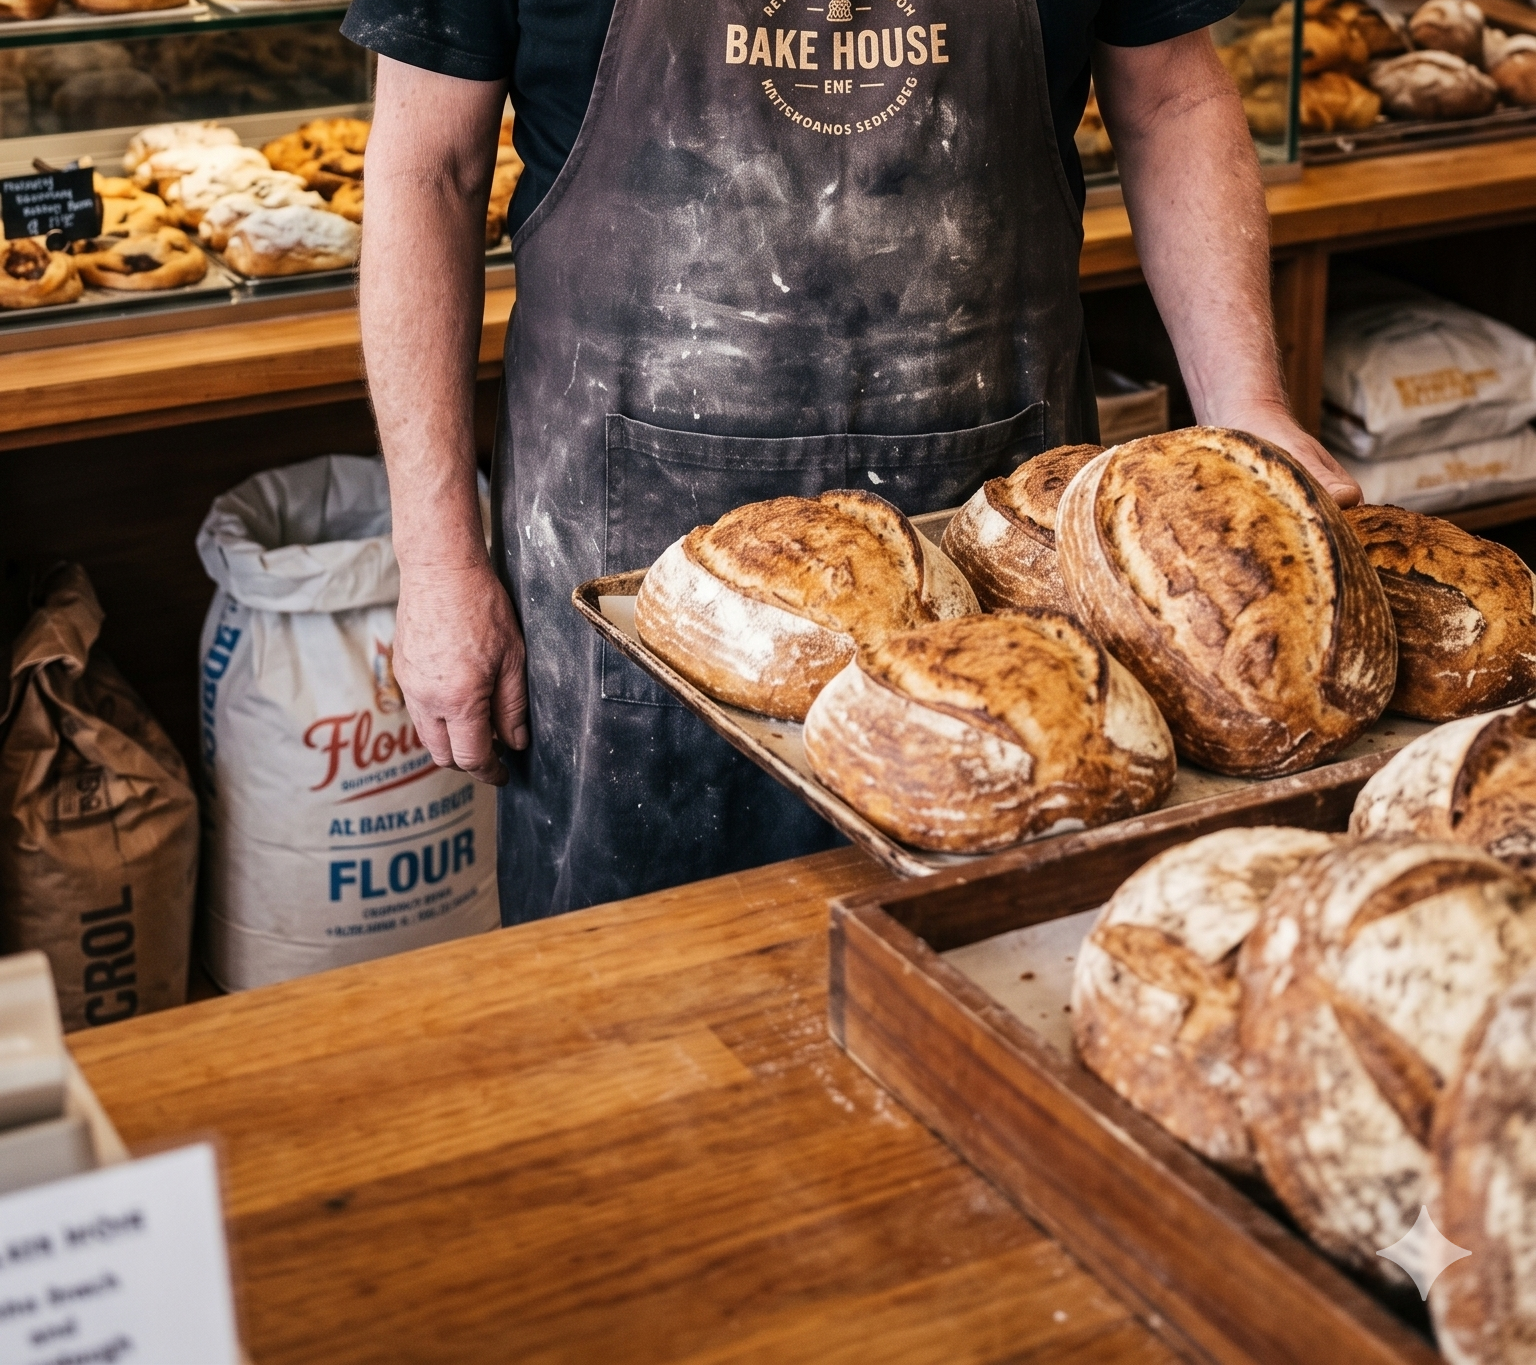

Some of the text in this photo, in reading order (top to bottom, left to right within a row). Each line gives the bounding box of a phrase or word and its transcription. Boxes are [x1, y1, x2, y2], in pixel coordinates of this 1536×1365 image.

[725, 23, 949, 70] BAKE HOUSE
[824, 79, 853, 94] ENE
[329, 828, 476, 902] FLOUR
